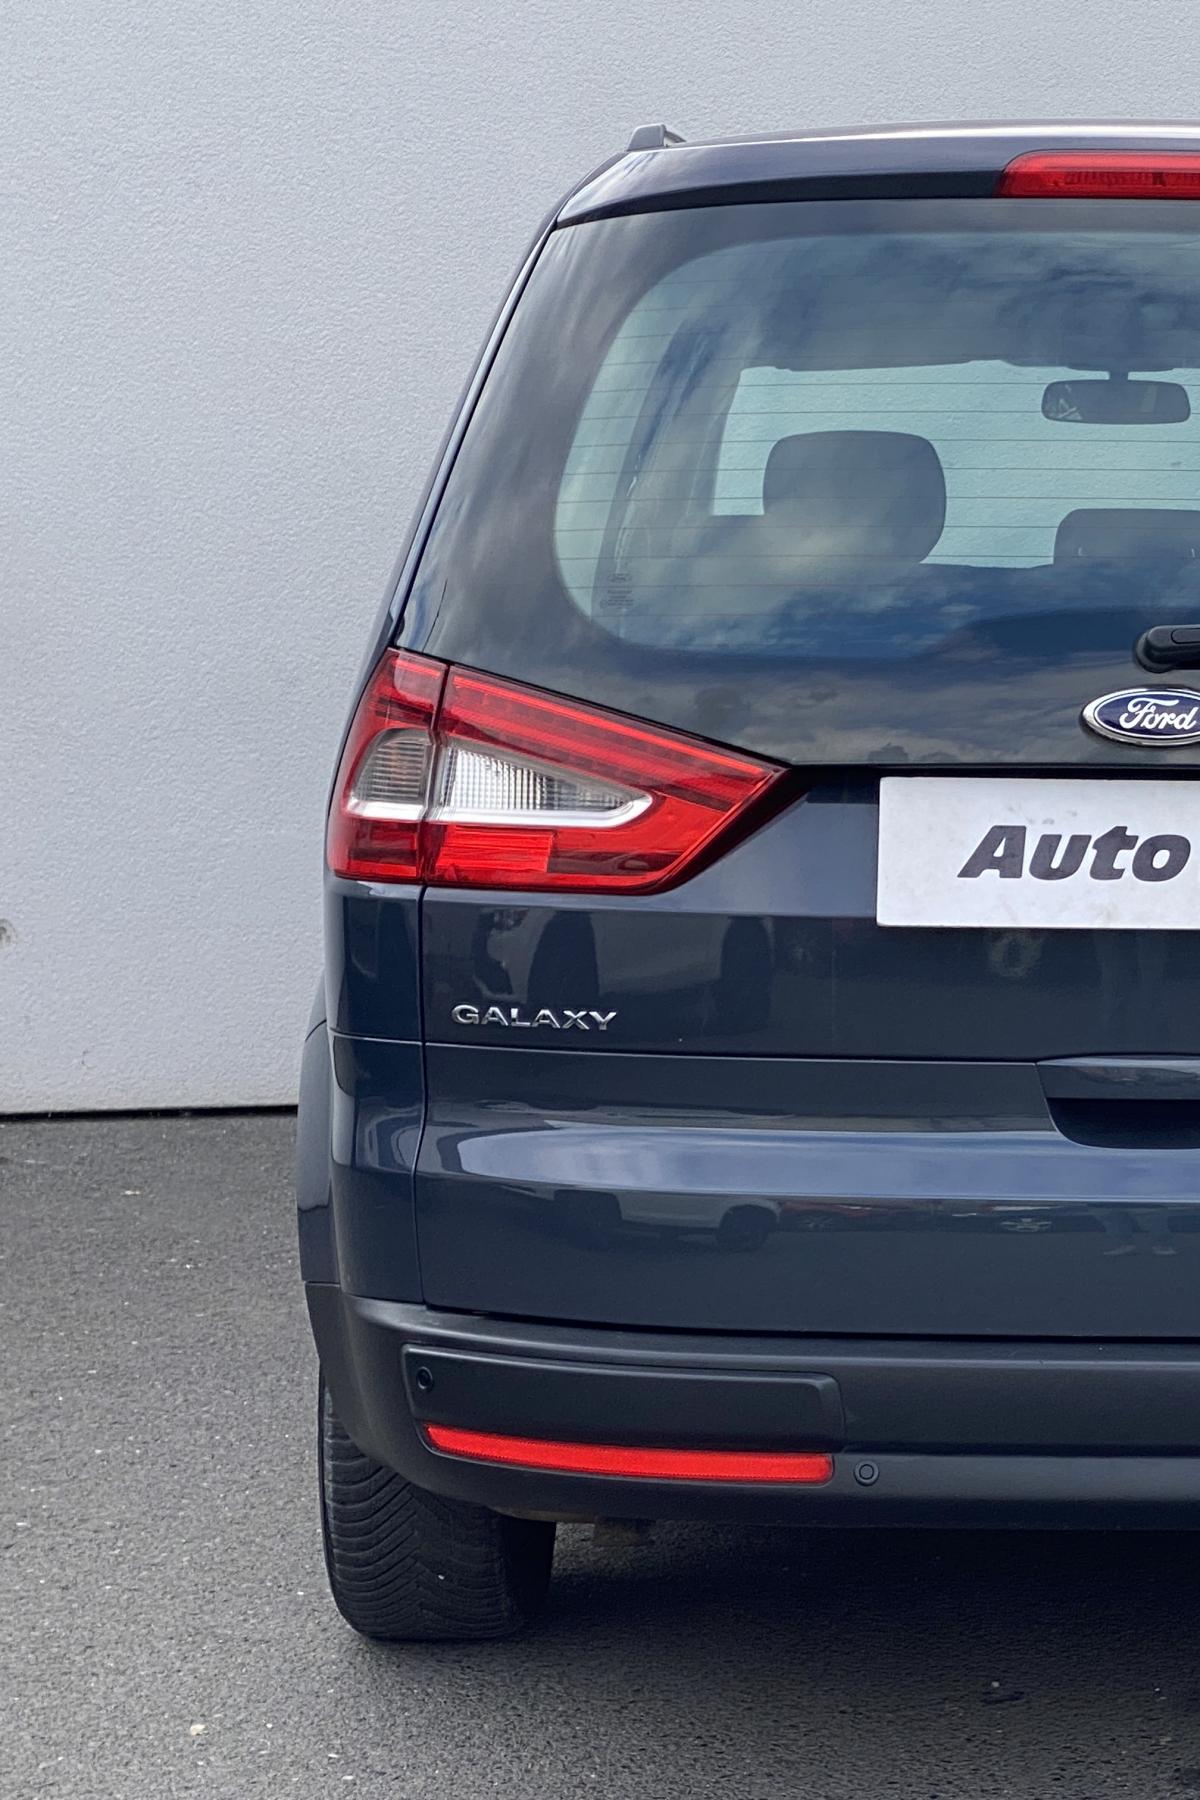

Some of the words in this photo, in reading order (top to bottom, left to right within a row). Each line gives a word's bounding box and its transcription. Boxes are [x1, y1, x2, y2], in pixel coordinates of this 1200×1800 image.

[1119, 697, 1199, 730] Ford
[957, 825, 1191, 882] Auto
[451, 1004, 617, 1030] GALAXY
